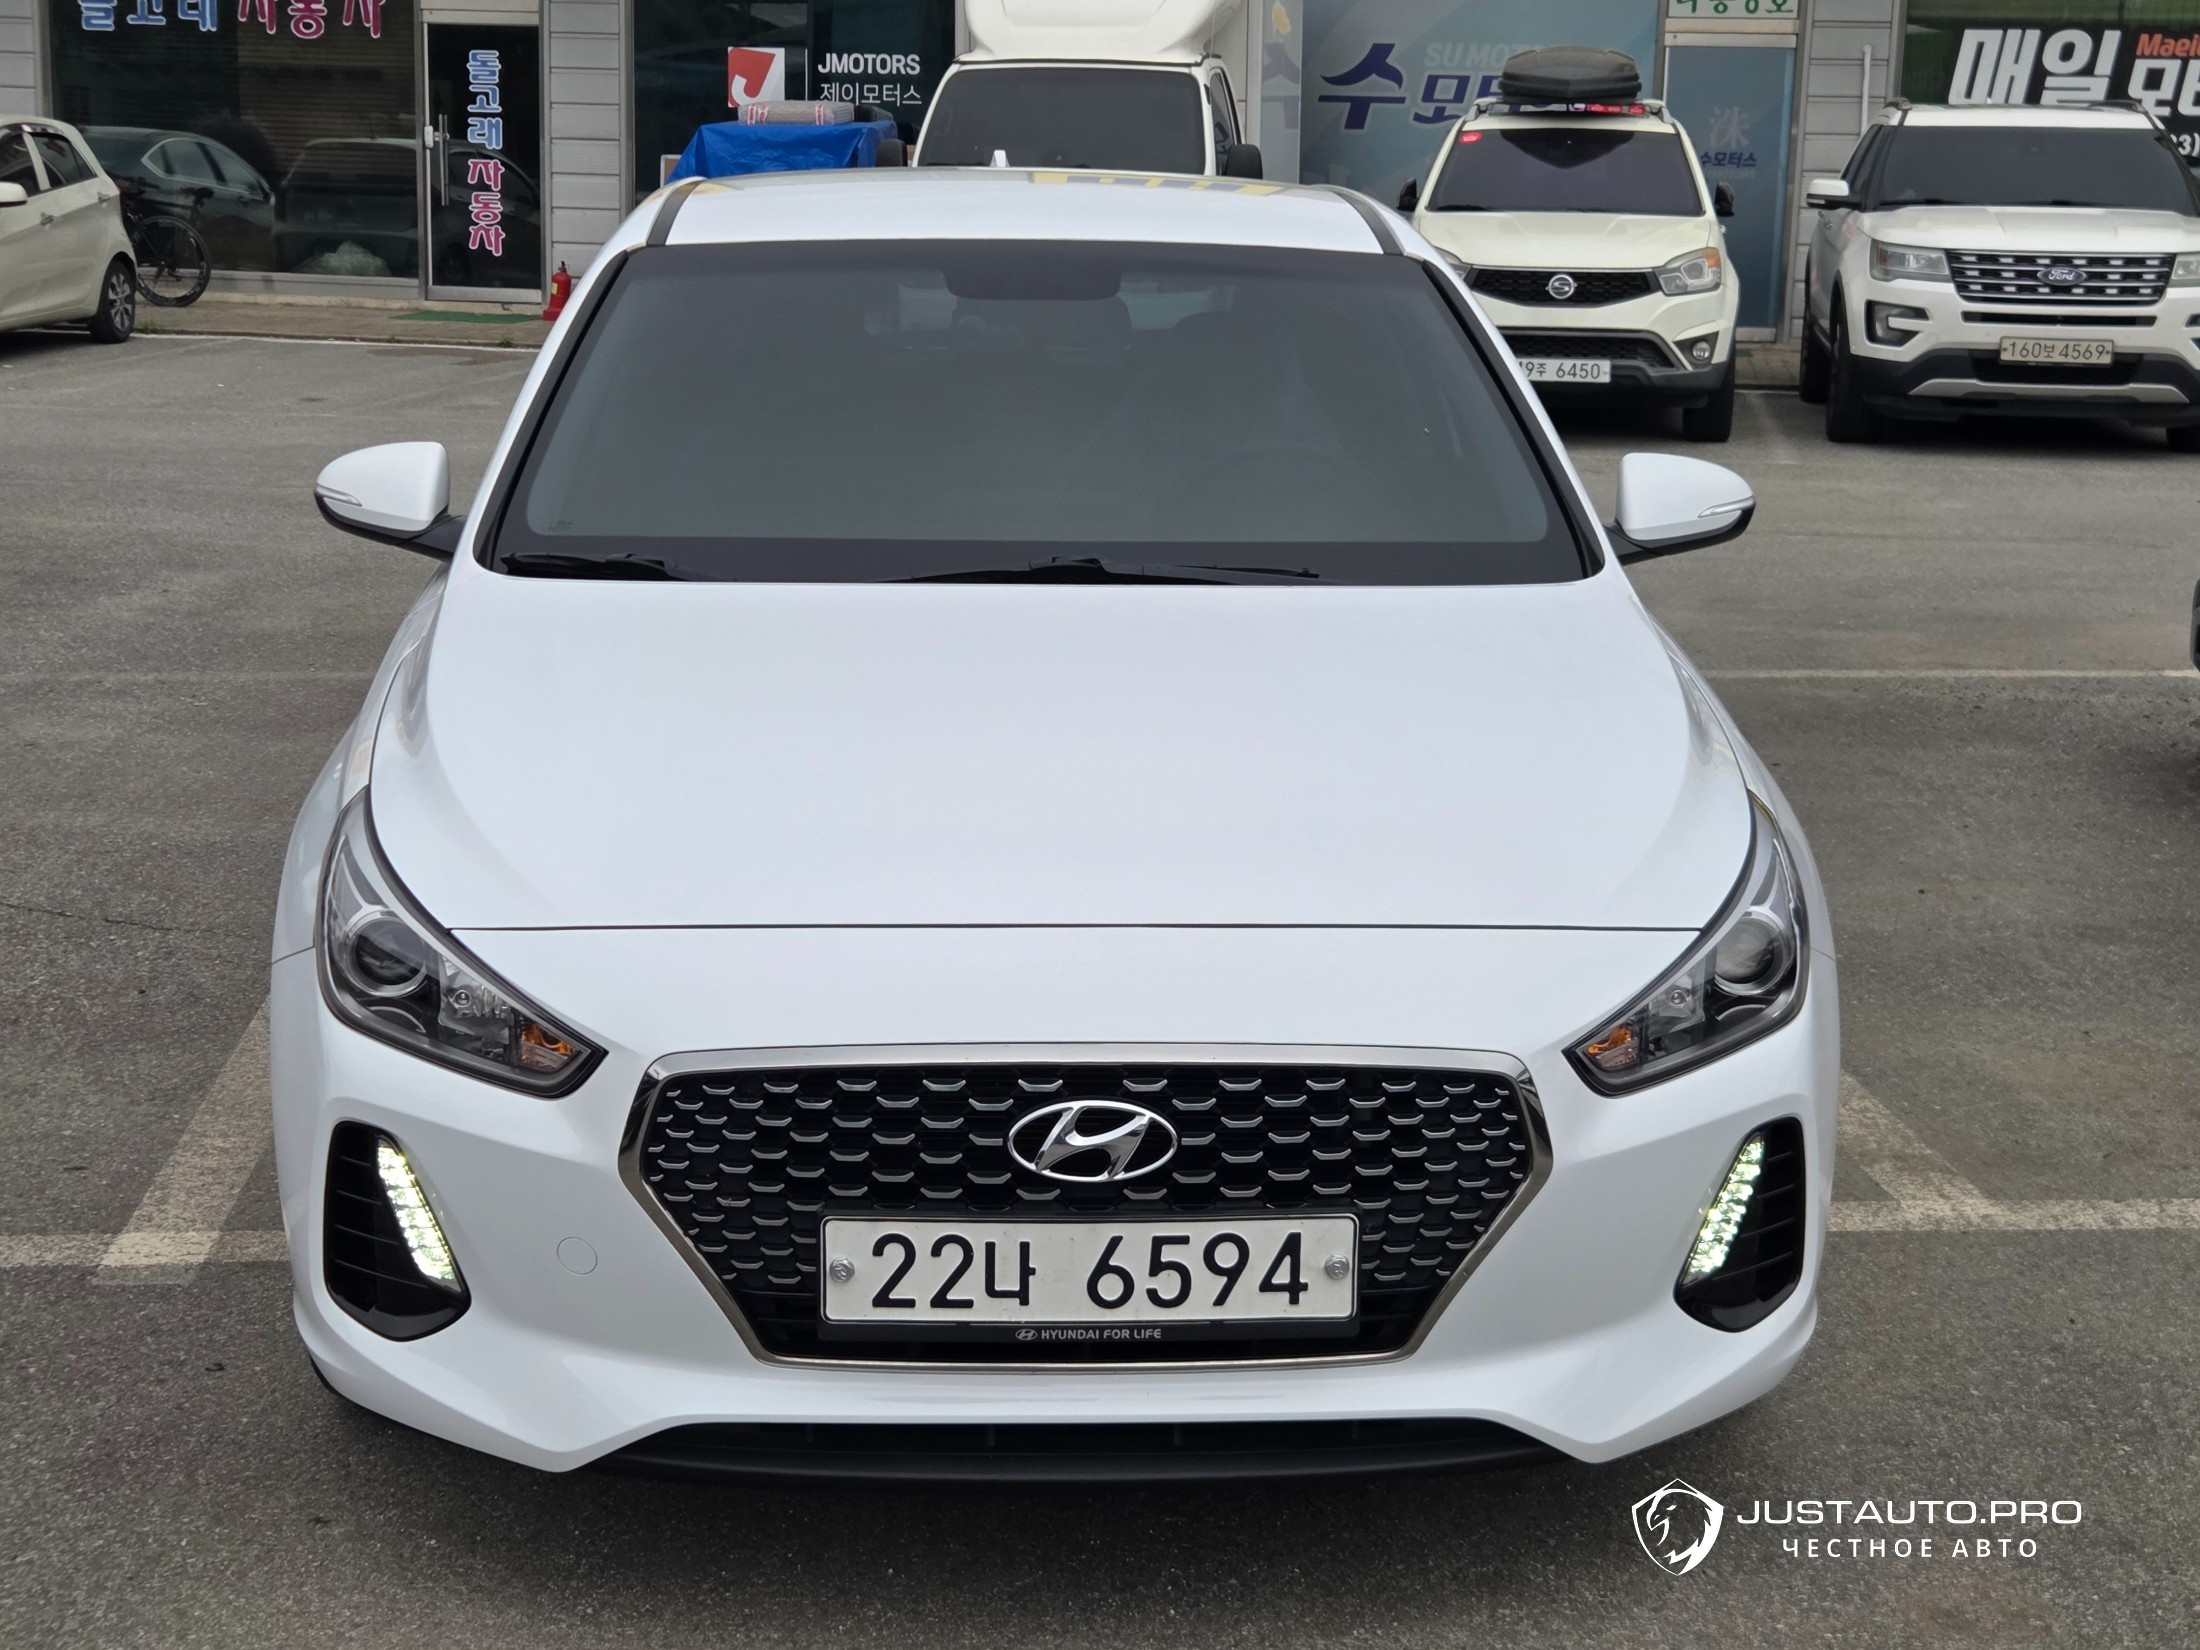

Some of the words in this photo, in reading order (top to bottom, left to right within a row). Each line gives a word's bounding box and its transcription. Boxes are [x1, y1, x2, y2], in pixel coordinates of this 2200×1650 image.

[817, 53, 921, 75] JMOTORS
[1948, 28, 2123, 106] 매일
[467, 50, 503, 149] 돌고래
[819, 82, 922, 107] 제이모터스
[1700, 151, 1757, 168] 수모터스
[468, 159, 506, 256] 자동차
[2048, 269, 2076, 281] Ford
[2009, 341, 2055, 359] 160보
[2058, 343, 2106, 361] 4569
[1556, 362, 1601, 380] 6450
[871, 1232, 1036, 1309] 22나
[1085, 1231, 1309, 1310] 6594
[1041, 1329, 1099, 1340] HYUNDAI
[1103, 1329, 1130, 1339] FOR
[1133, 1328, 1162, 1339] LIFE
